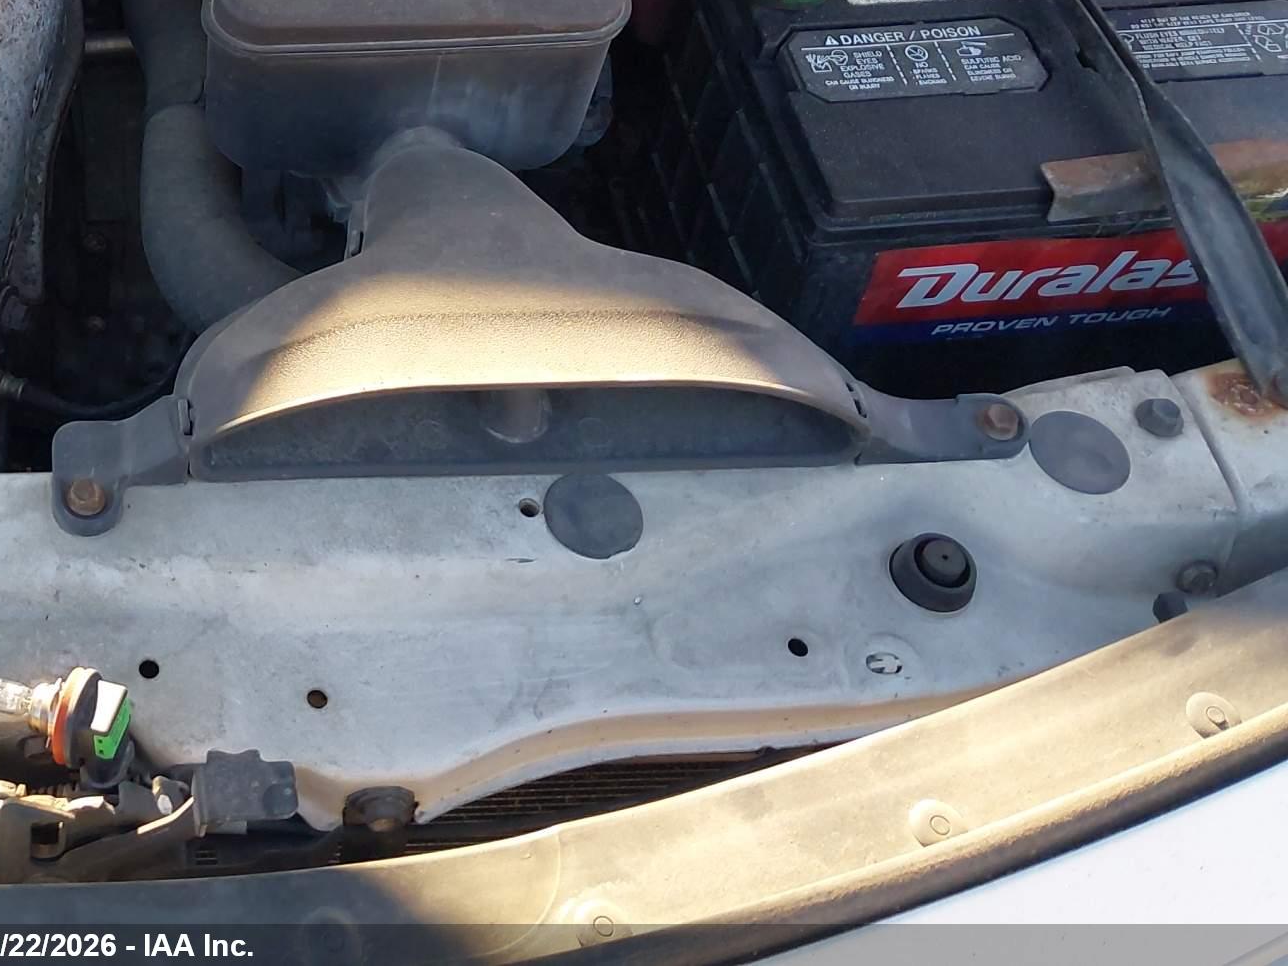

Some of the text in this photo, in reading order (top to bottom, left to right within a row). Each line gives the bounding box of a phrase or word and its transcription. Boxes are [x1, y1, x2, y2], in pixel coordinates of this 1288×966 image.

[839, 32, 905, 46] DANGER
[920, 25, 981, 40] POISON
[853, 50, 882, 59] SHIELD
[840, 63, 885, 72] EXPLOSIVE
[843, 70, 872, 78] GASES
[895, 250, 1200, 309] Duralas
[930, 306, 1172, 335] PROVEN TOUGH
